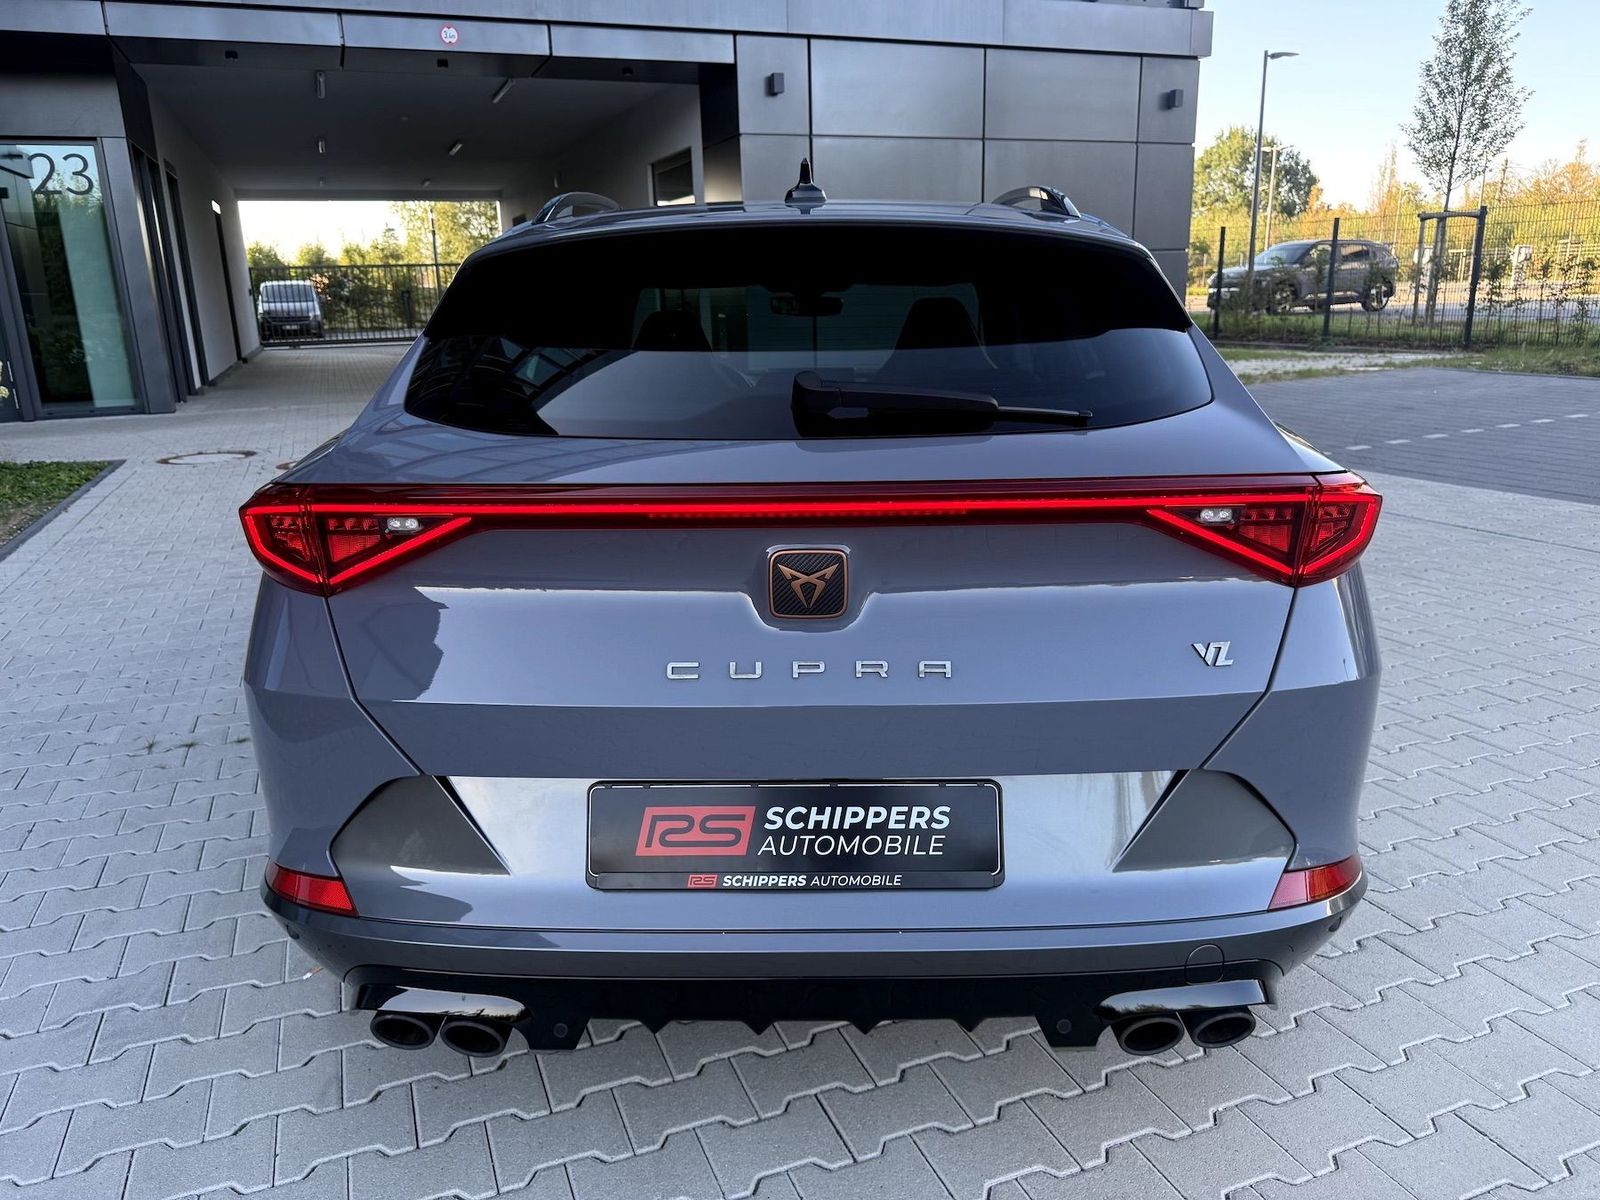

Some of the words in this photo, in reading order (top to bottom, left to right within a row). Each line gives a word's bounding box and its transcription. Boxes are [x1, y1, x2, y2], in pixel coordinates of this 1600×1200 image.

[28, 153, 93, 195] 23
[666, 660, 952, 680] CUPRA
[764, 806, 951, 830] SCHIPPERS
[643, 812, 748, 849] RS
[757, 835, 945, 856] AUTOMOBILE
[722, 875, 807, 888] SCHIPPERS
[810, 875, 902, 887] AUTOMOBILE
